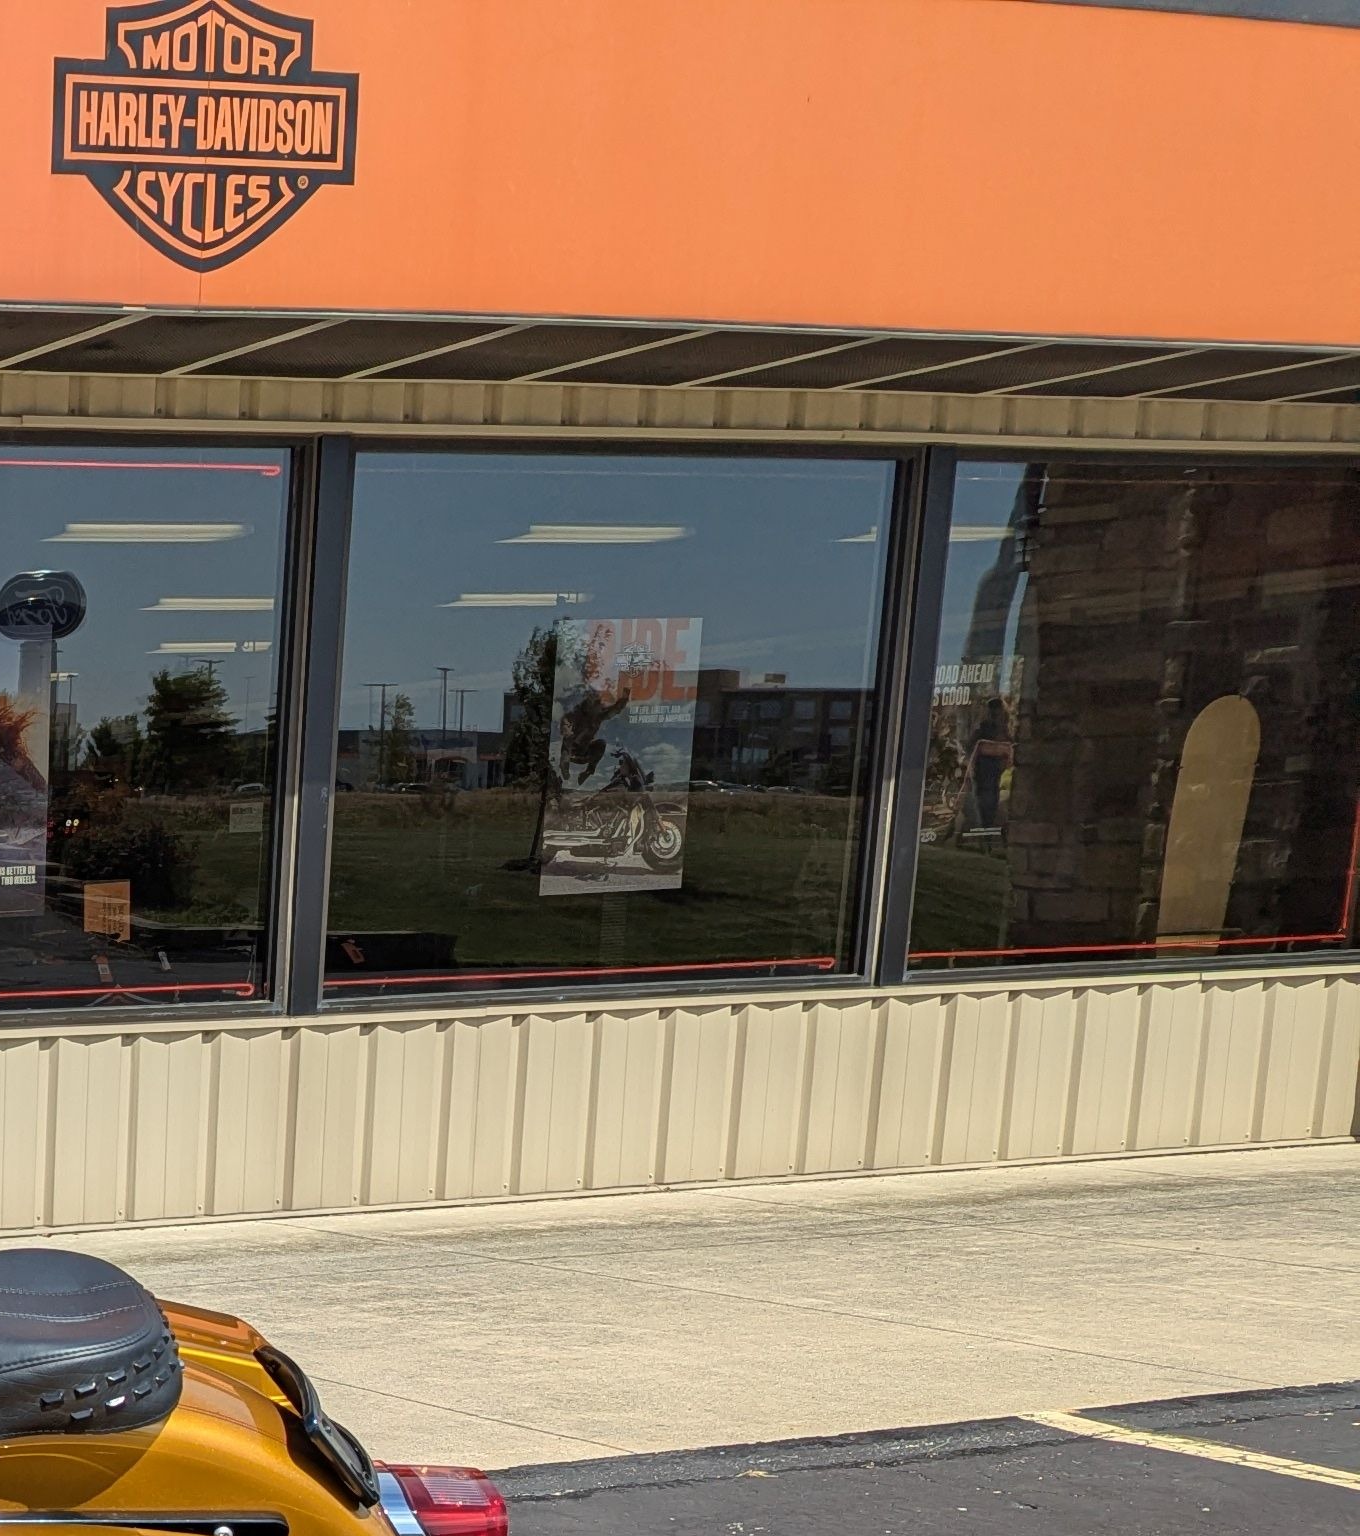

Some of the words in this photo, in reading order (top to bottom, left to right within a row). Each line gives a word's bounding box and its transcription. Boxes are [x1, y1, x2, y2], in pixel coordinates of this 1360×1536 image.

[142, 9, 278, 77] MOTOR
[78, 89, 334, 156] HARLEY-DAVIDSON
[136, 170, 271, 244] CYCLES
[960, 663, 994, 683] AHEAD
